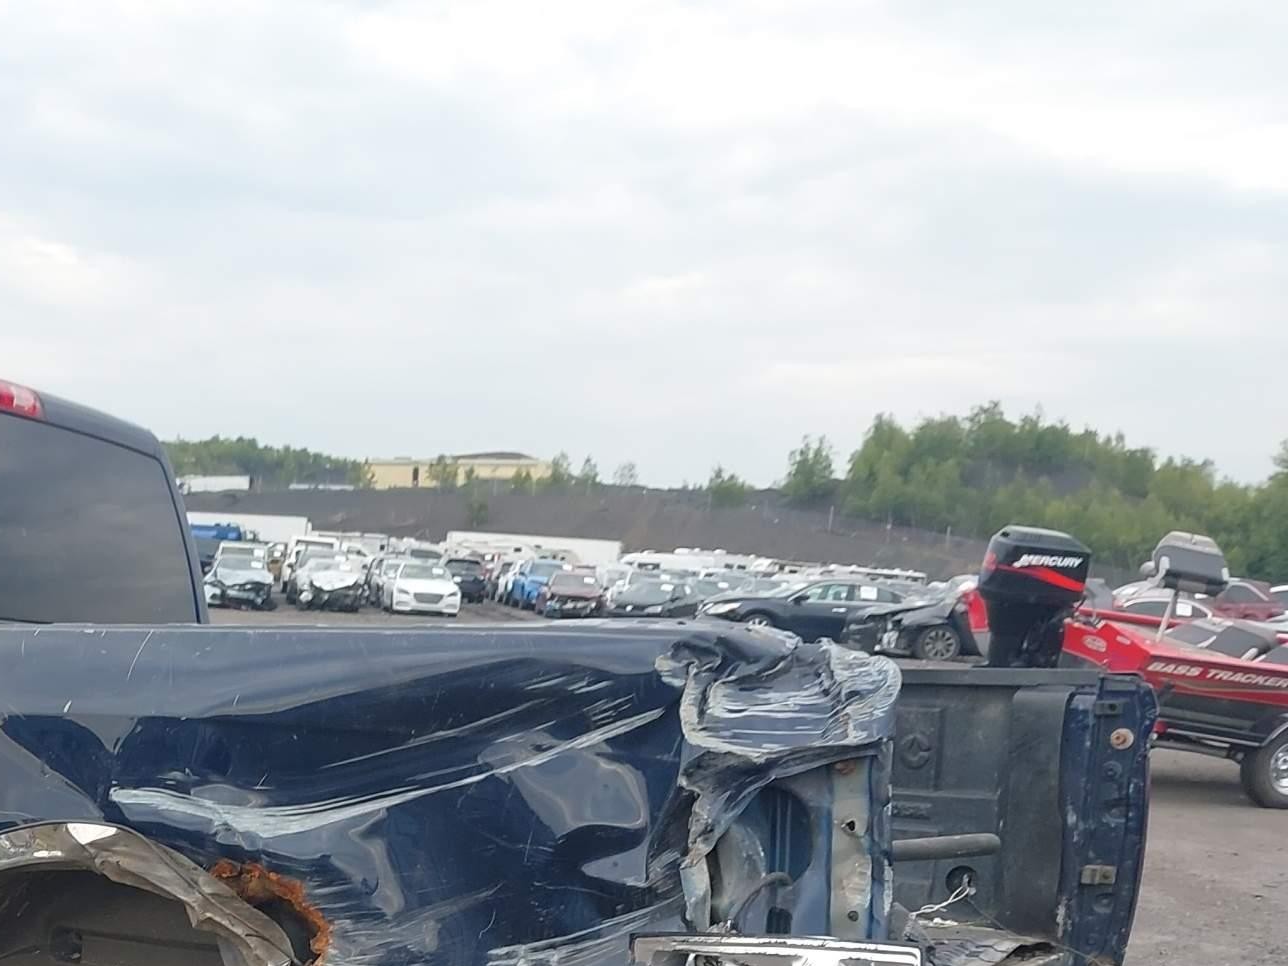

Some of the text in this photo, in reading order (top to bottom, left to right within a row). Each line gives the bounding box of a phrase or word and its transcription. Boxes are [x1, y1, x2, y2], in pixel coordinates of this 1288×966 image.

[1012, 553, 1084, 569] MERCURY
[1146, 661, 1288, 688] BASS TRACKER
